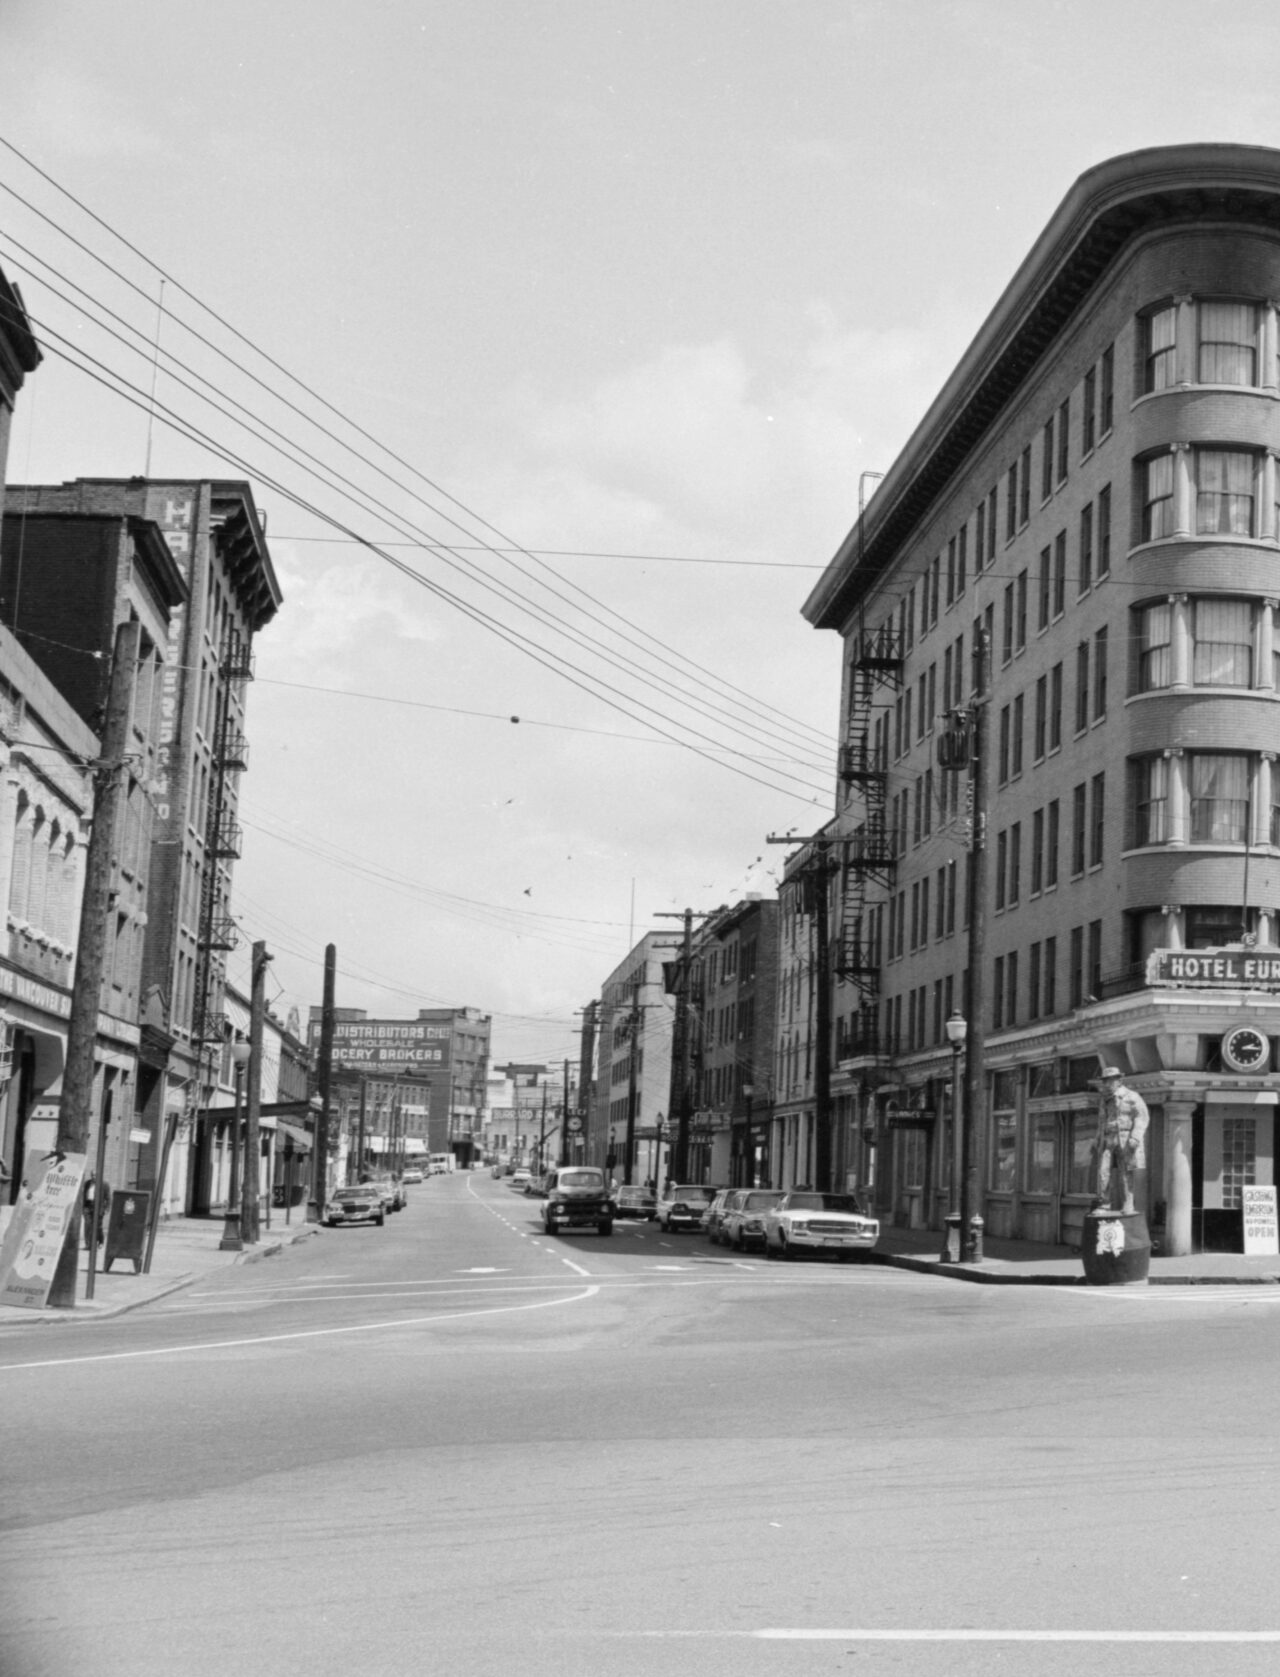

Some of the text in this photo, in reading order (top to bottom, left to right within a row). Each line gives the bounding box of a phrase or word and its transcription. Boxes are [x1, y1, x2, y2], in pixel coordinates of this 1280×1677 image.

[1171, 958, 1239, 979] HOTEL
[337, 1026, 425, 1039] DISTRIBUTORS
[350, 1039, 415, 1048] WHOLESALE
[379, 1049, 442, 1061] BROKERS
[493, 1110, 533, 1121] BURRARD
[1247, 1226, 1275, 1238] OPEN
